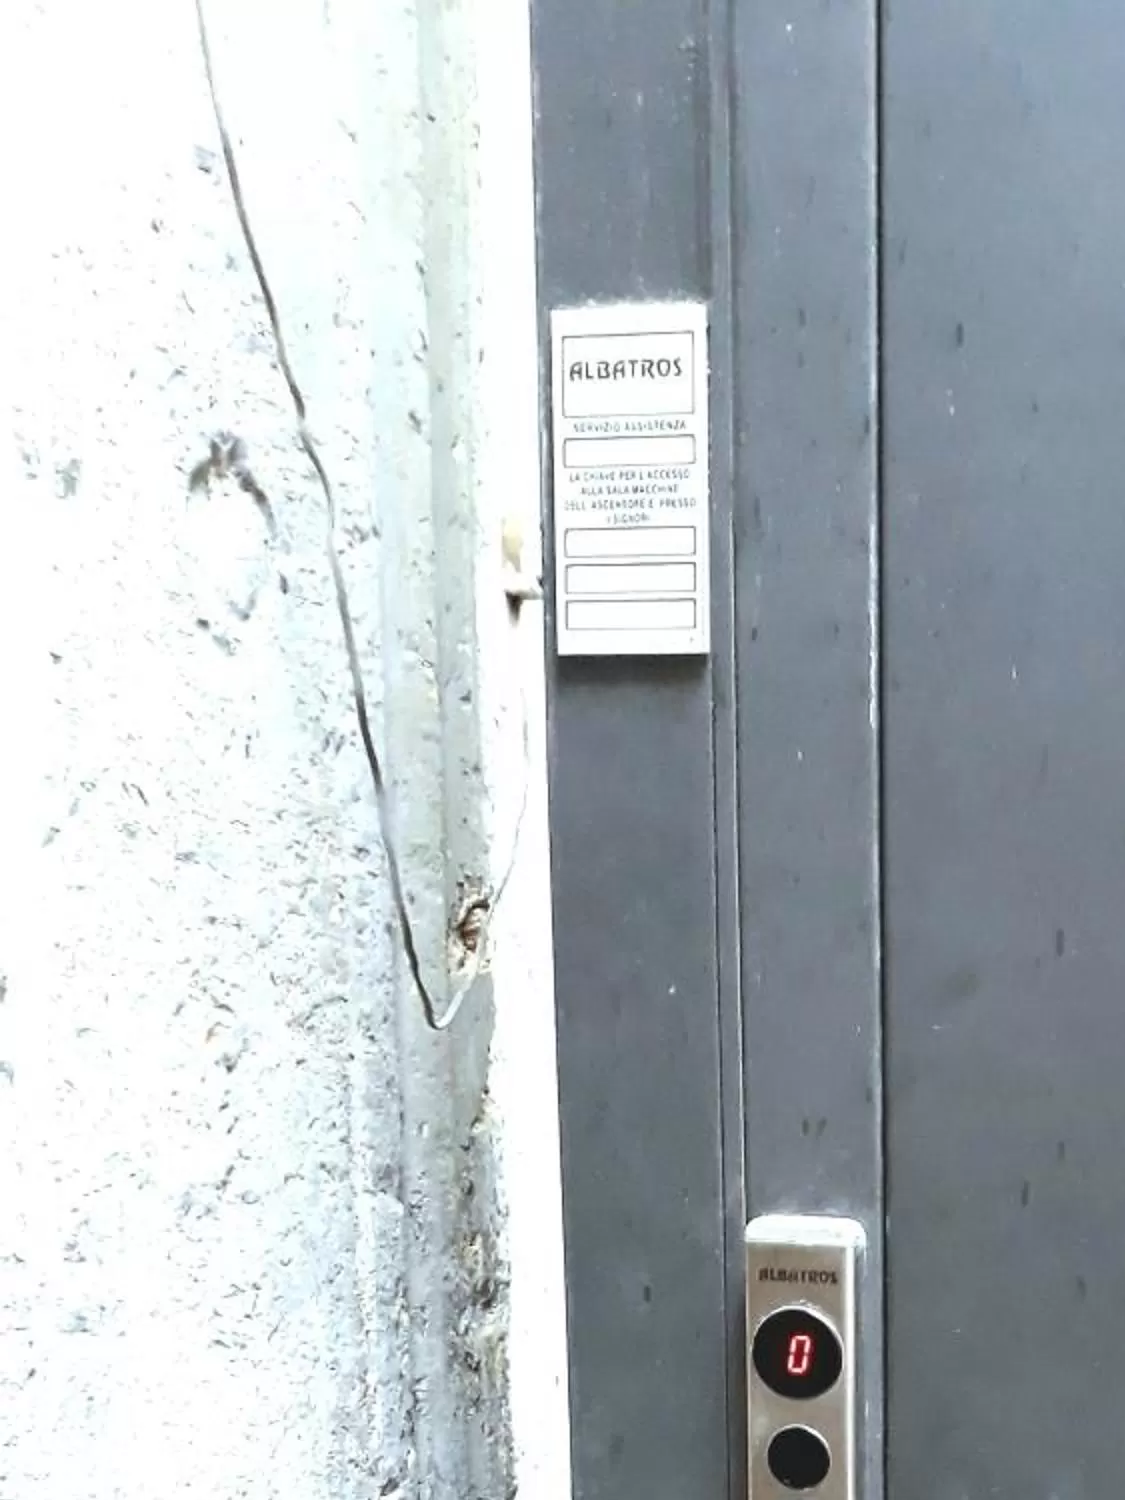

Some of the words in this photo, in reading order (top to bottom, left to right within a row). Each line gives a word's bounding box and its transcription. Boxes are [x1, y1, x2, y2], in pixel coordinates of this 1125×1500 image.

[569, 356, 683, 382] ALBATROS
[573, 421, 621, 433] SERVIZIO
[758, 1267, 838, 1285] ALBATROS
